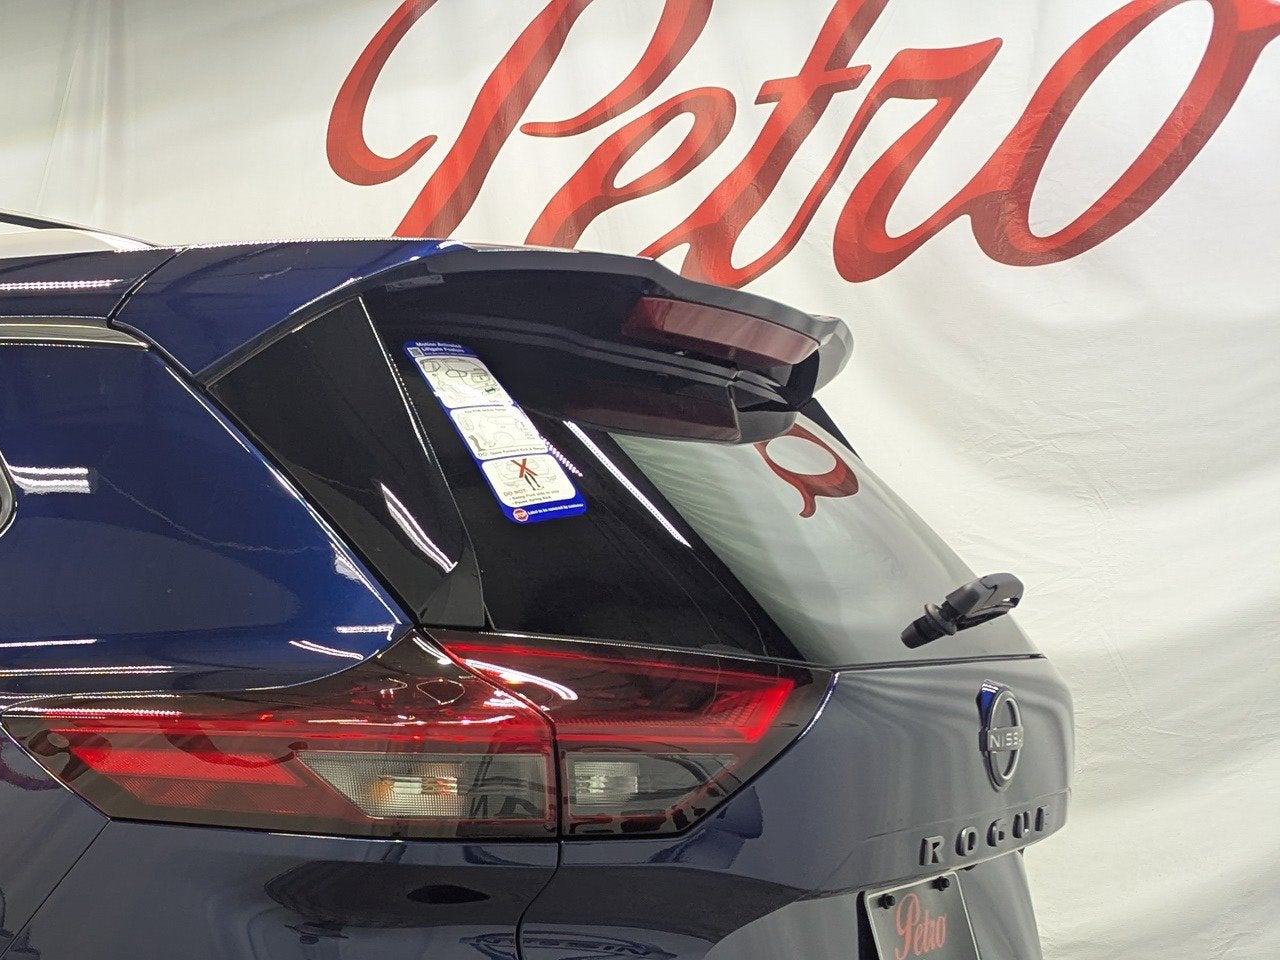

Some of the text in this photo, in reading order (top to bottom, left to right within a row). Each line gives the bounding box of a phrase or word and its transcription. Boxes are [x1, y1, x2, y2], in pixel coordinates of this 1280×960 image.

[327, 0, 1280, 284] Petro
[989, 730, 1023, 749] NISS
[894, 893, 948, 960] Petro
